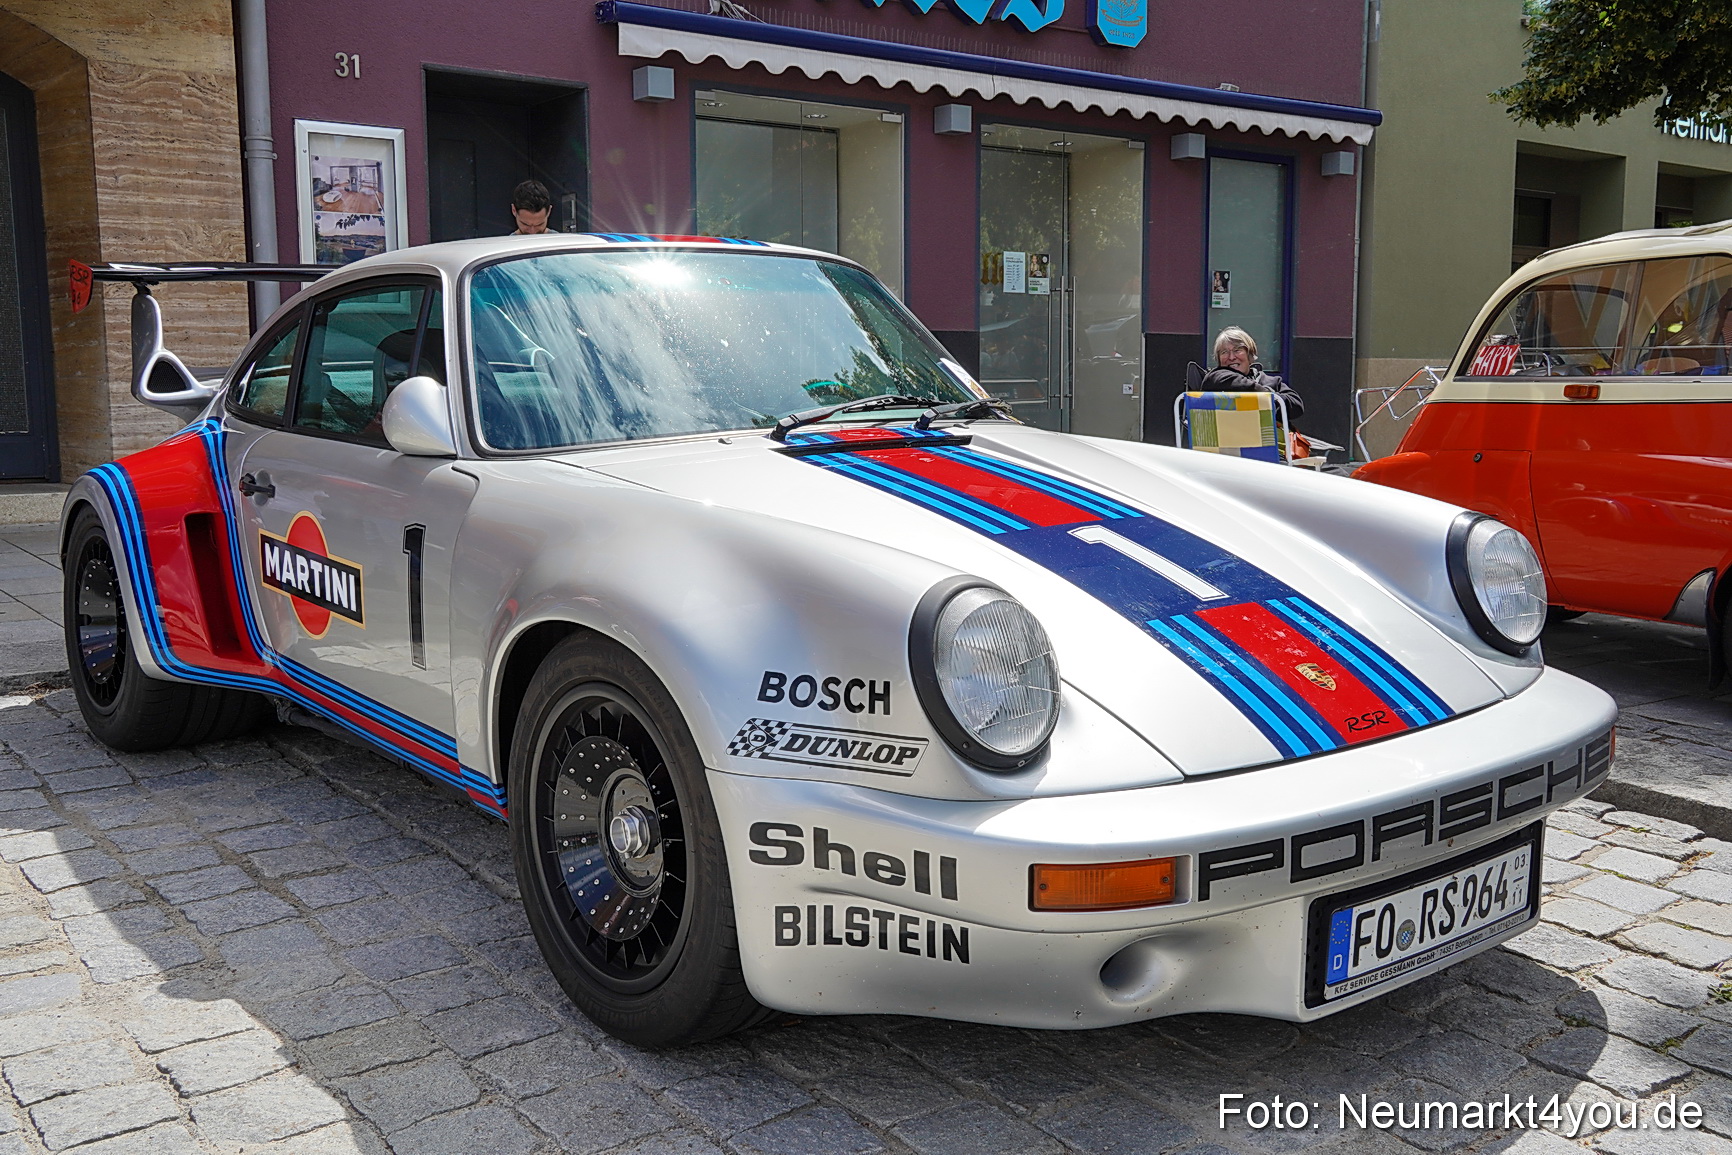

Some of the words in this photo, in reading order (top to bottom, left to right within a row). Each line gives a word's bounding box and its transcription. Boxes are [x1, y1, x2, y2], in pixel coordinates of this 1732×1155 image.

[334, 51, 361, 79] 31
[1470, 345, 1520, 376] HAPPY
[264, 542, 357, 613] MARTINI
[1066, 524, 1231, 601] 1
[402, 522, 427, 672] 1
[757, 670, 891, 715] BOSCH
[1344, 710, 1390, 733] RSR
[780, 733, 920, 765] DUNLOP
[1198, 730, 1611, 902] PORSCHE
[748, 821, 959, 901] Shell
[1514, 853, 1526, 870] 03
[774, 904, 970, 965] BILSTEIN
[1352, 902, 1396, 968] FO
[1332, 953, 1343, 971] D
[1334, 983, 1348, 994] KFZ
[1349, 973, 1379, 990] SERVICE
[1380, 959, 1416, 979] GESSMANN
[1416, 952, 1435, 965] GmbH
